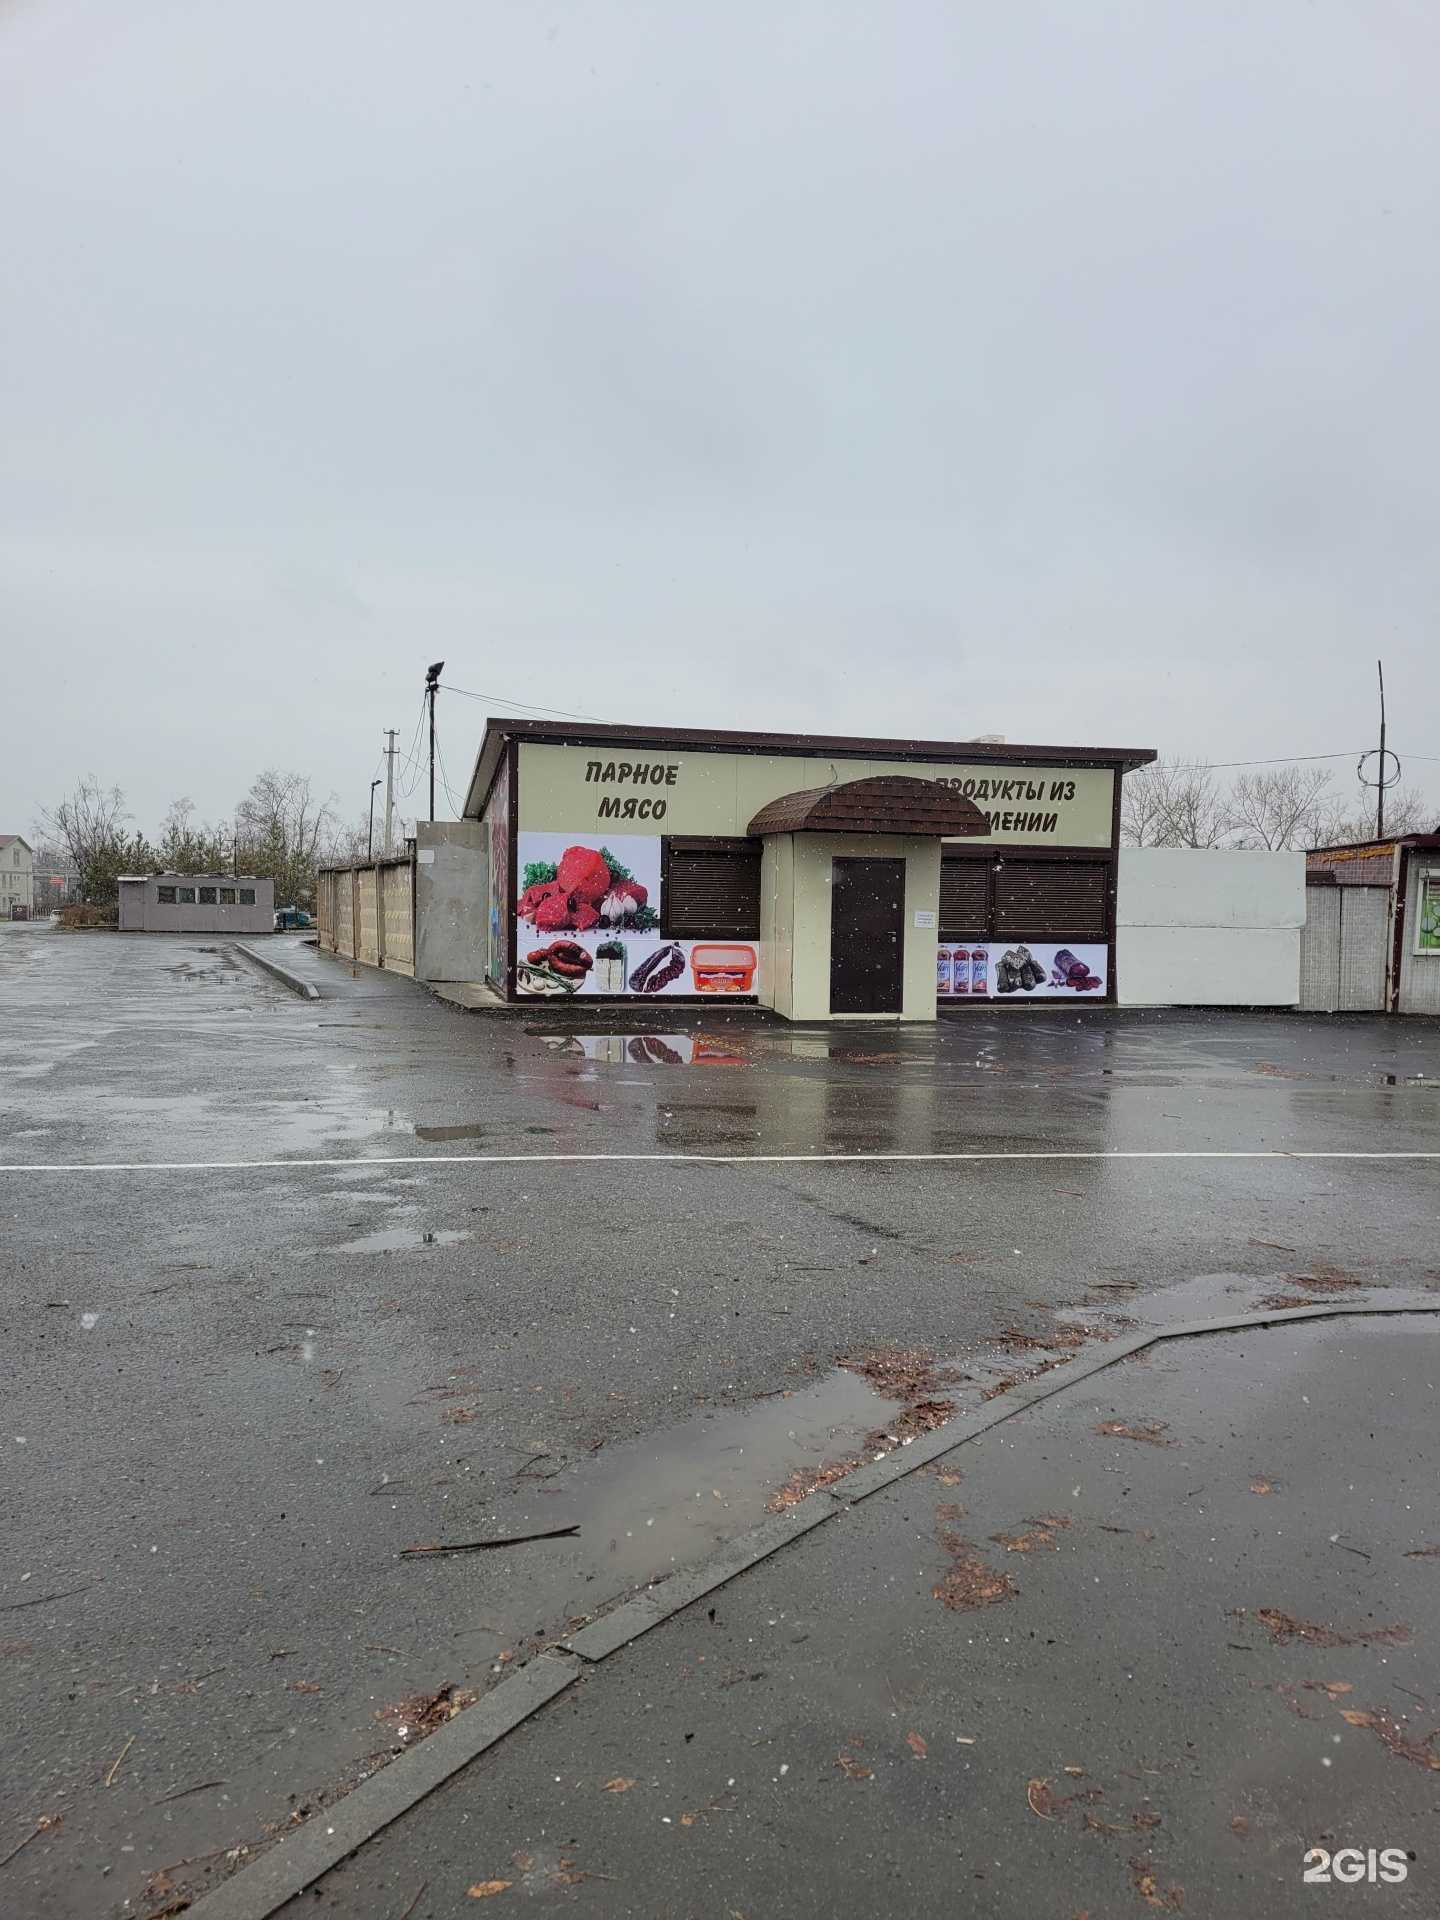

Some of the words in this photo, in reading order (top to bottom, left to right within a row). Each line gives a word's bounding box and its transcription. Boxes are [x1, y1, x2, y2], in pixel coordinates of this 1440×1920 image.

[585, 761, 679, 785] ПАРНОЕ
[1049, 781, 1076, 801] ИЗ
[598, 796, 667, 820] МЯСО
[984, 811, 1059, 832] МЕНИИ
